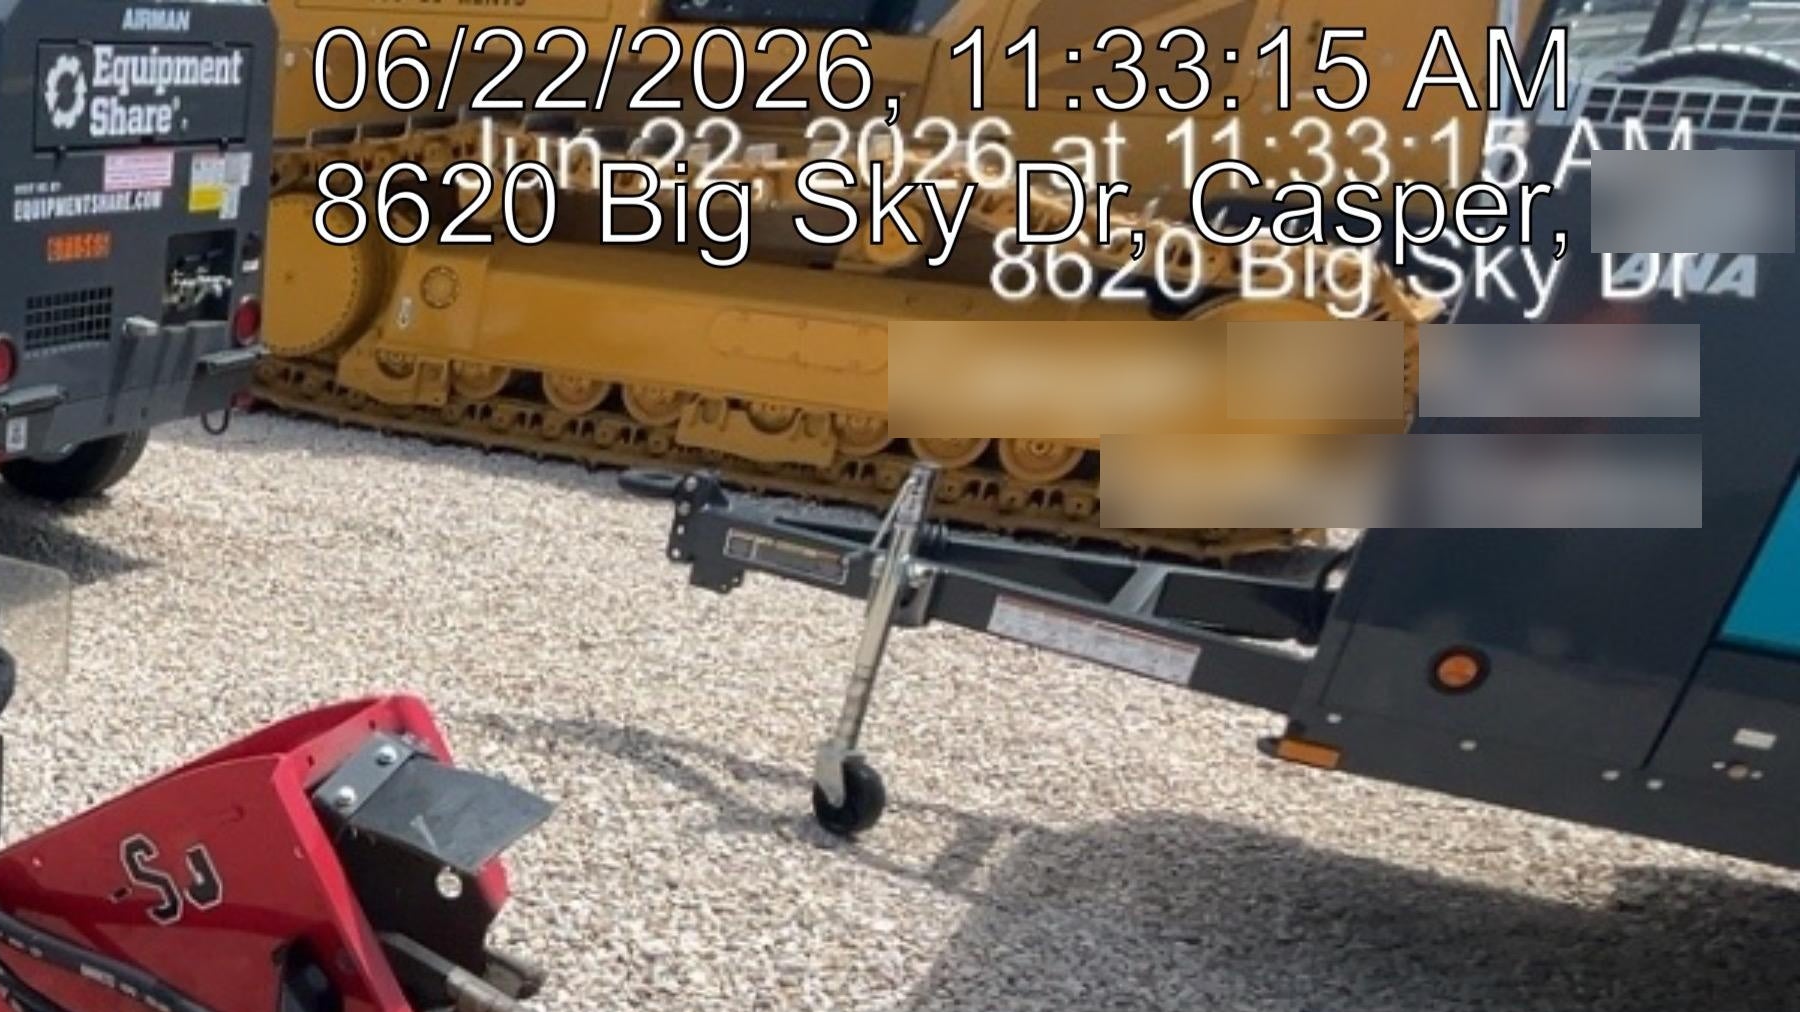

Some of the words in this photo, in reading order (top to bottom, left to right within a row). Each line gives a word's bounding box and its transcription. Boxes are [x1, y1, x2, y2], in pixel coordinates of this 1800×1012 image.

[122, 7, 191, 31] AIRMAN
[92, 45, 244, 96] Equipment
[89, 95, 174, 136] Share
[13, 189, 163, 223] EQUIPMENTSHARE.COM
